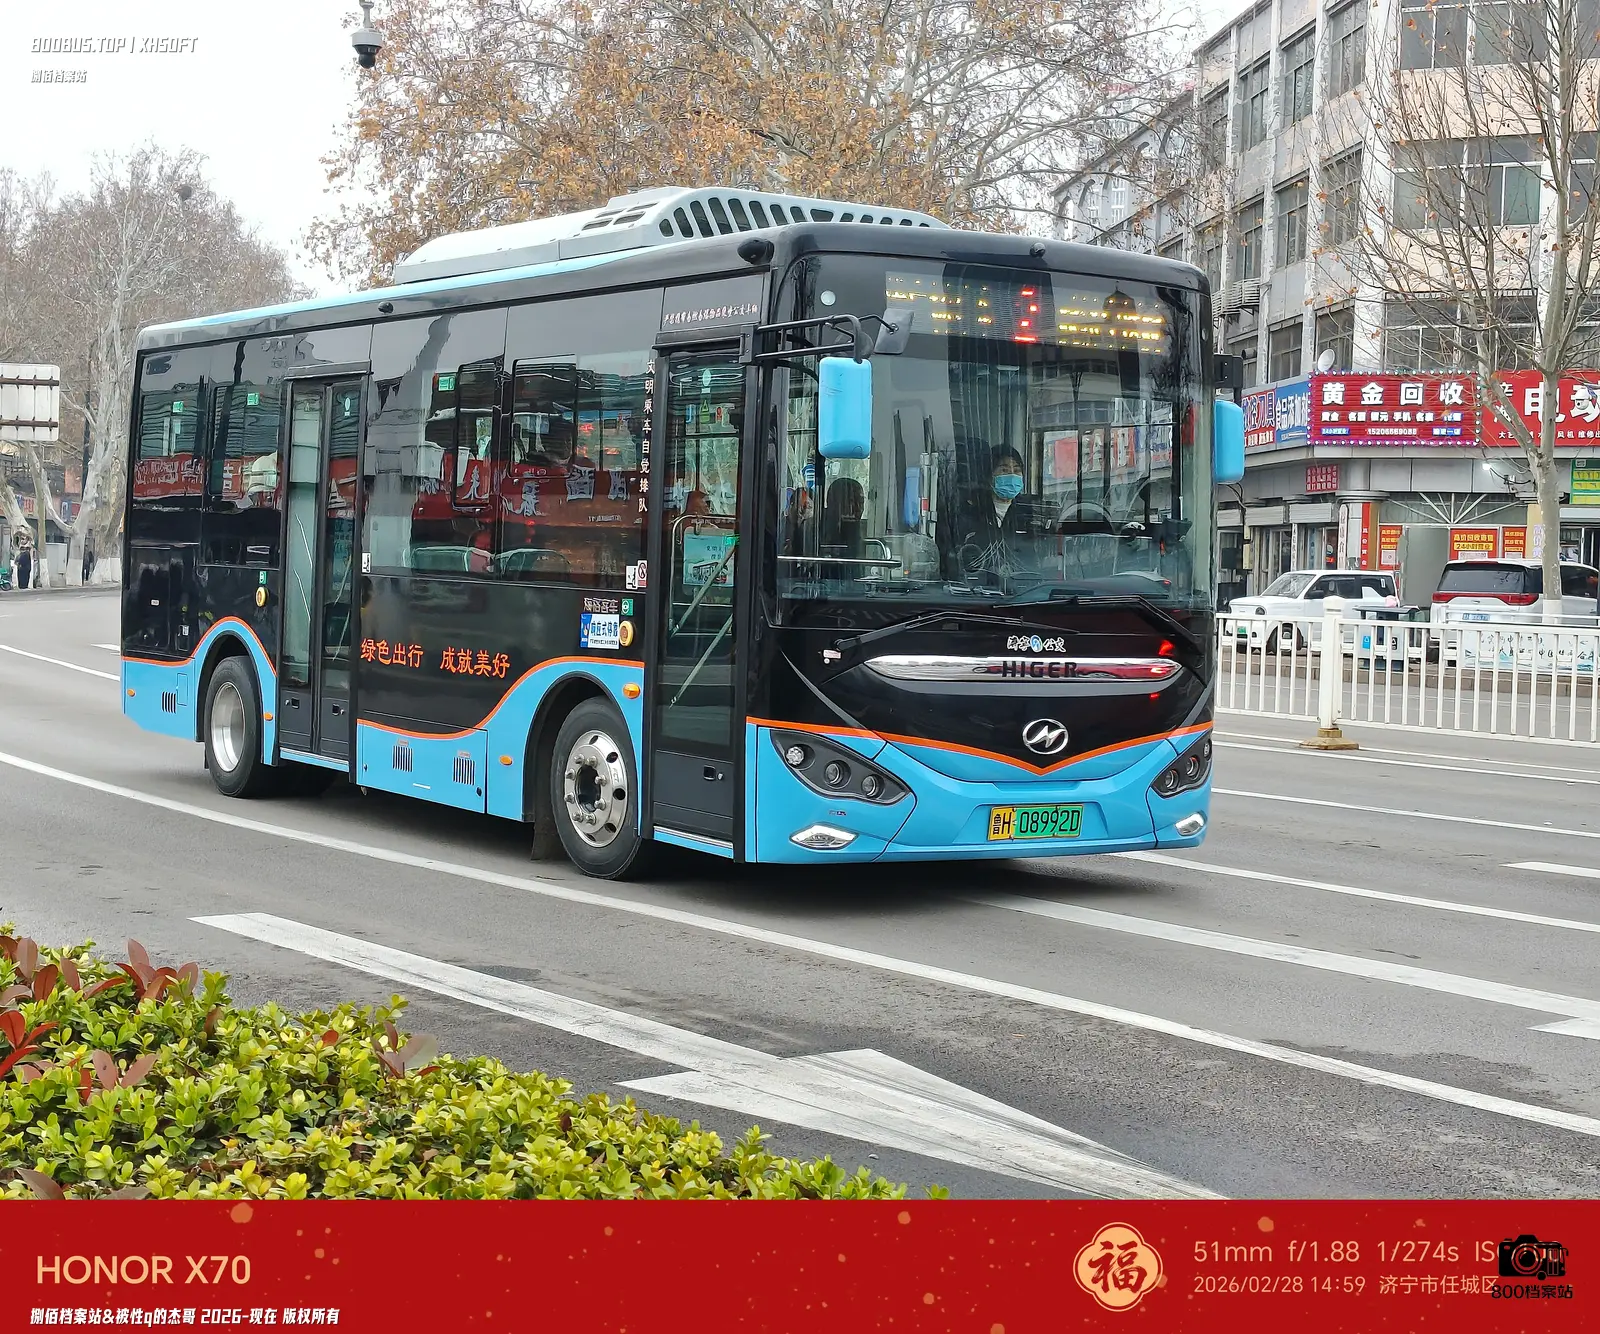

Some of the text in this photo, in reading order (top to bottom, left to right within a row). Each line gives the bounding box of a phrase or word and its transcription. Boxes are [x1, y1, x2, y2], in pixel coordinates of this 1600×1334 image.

[1322, 382, 1464, 406] 黄金回收
[1393, 411, 1412, 422] 手机
[637, 358, 656, 514] 文明乘车自觉排队
[1557, 430, 1575, 439] 风机
[360, 637, 512, 680] 绿色出行 成就美好
[1001, 660, 1078, 677] HIGER
